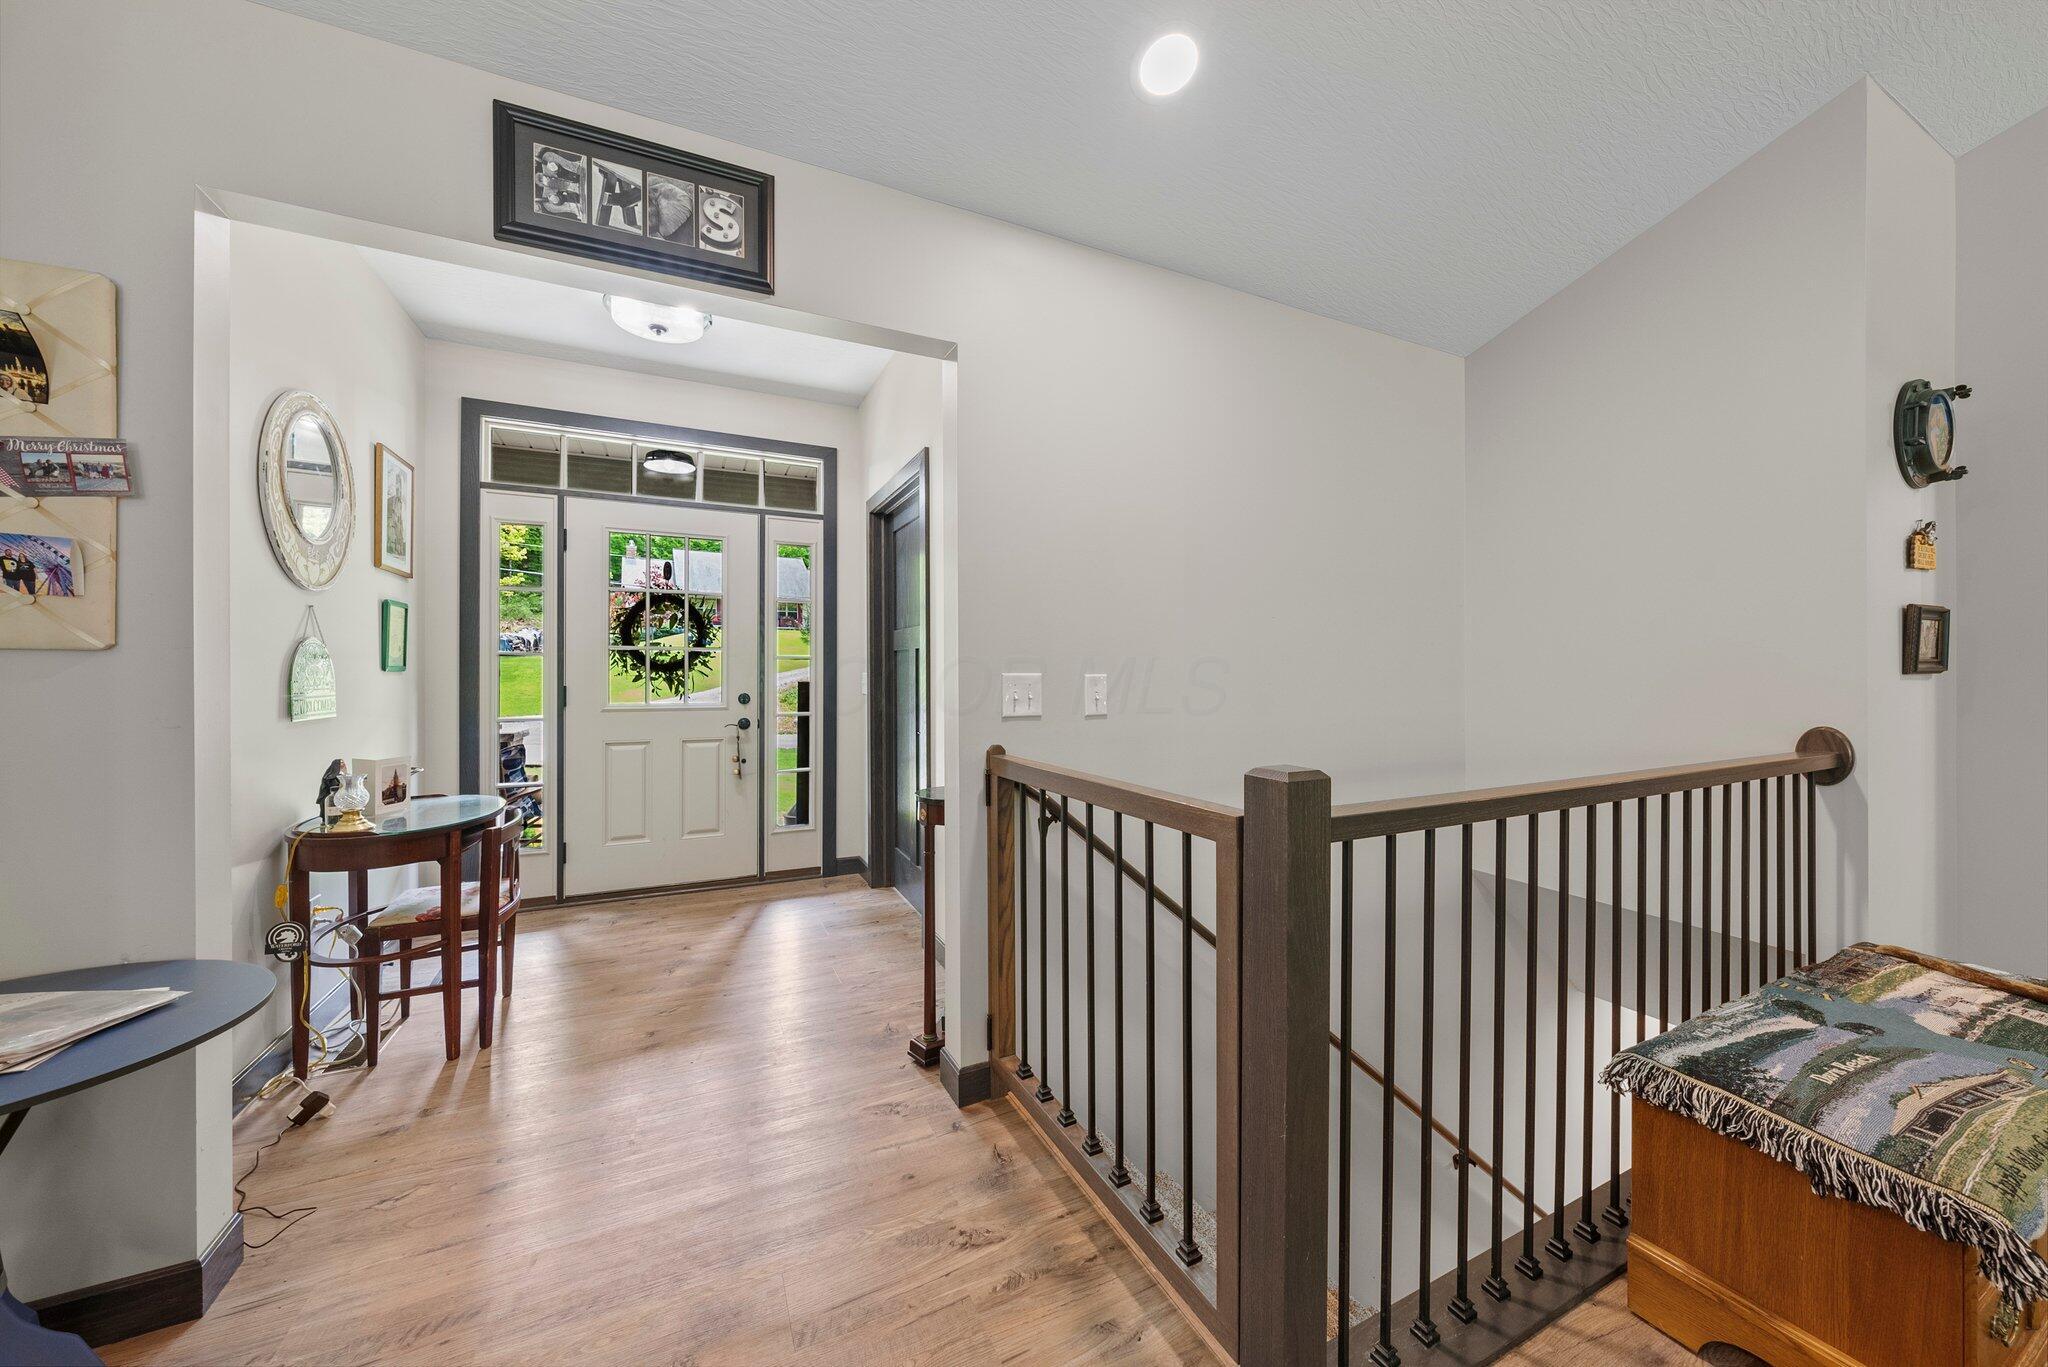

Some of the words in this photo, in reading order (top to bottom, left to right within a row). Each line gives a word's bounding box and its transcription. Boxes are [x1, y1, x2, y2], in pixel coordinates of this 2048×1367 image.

[7, 439, 54, 455] Merry
[57, 440, 123, 453] Christmas
[1830, 1053, 1880, 1072] Beach
[1984, 1162, 2028, 1203] Apple
